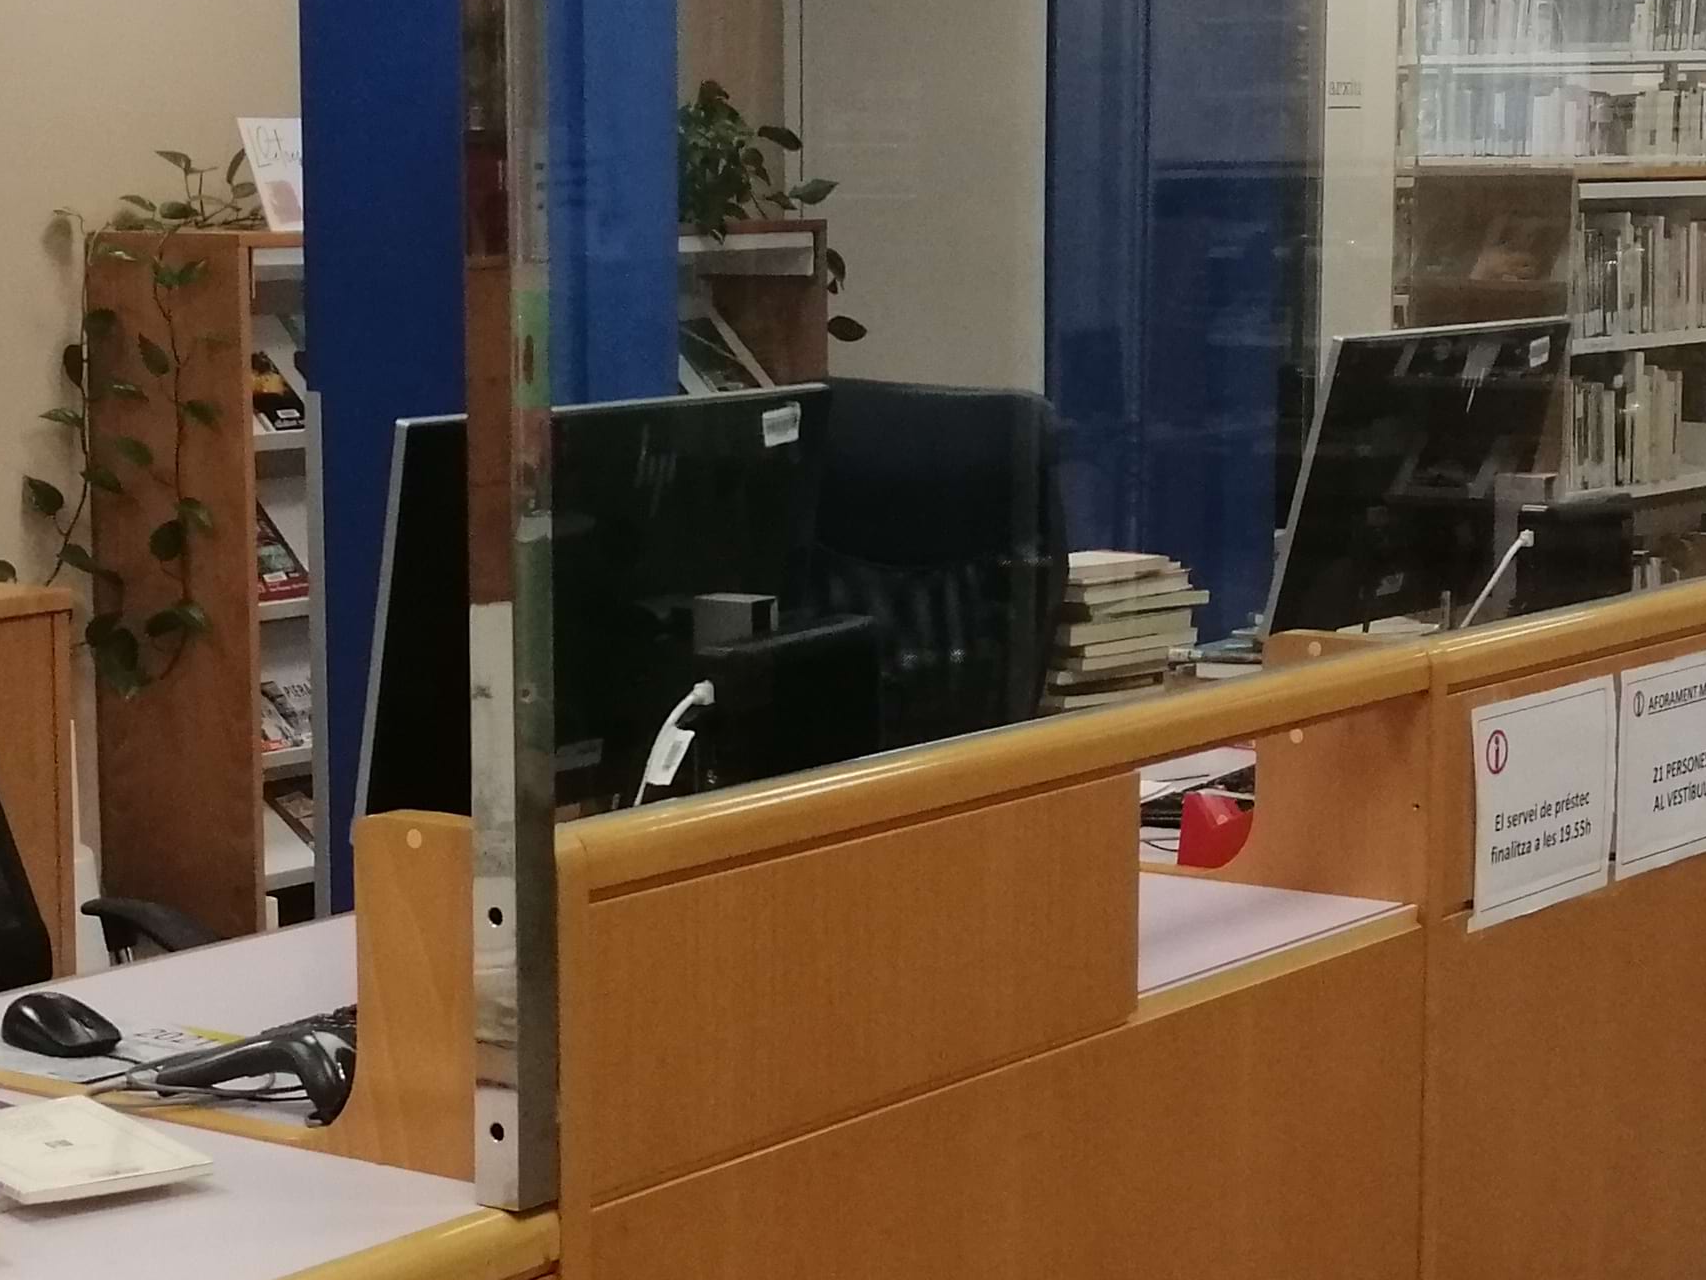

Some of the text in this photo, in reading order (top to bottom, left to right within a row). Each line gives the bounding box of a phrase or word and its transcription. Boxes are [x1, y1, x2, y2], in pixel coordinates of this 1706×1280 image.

[1648, 686, 1698, 710] AFORAMENT
[1652, 766, 1664, 784] 21
[1495, 791, 1590, 832] El servei de préstec
[1653, 795, 1665, 813] AL
[1491, 818, 1591, 864] finalitza a les 19.55h
